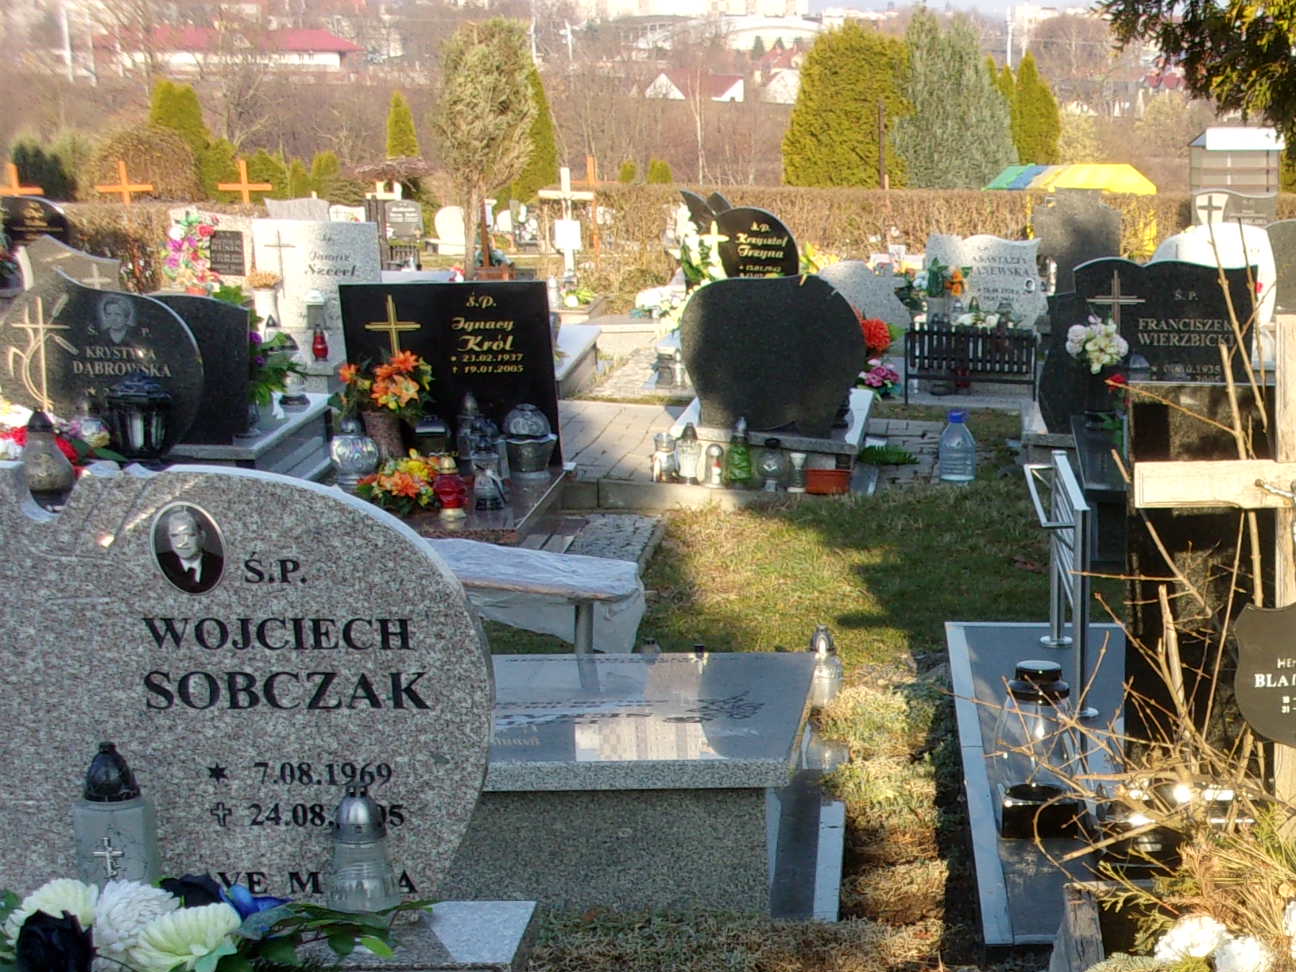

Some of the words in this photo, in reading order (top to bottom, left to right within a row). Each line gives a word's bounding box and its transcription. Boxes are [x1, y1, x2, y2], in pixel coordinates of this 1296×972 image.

[451, 317, 515, 332] Ignacy
[1137, 318, 1232, 330] FRANCISZEK
[457, 335, 514, 351] Król
[1137, 332, 1235, 347] WIERZBICKI
[85, 347, 158, 361] KRYSTYA
[72, 360, 173, 379] DĄBROWSKA
[143, 617, 415, 651] WOJCIECH
[143, 671, 432, 711] SOBCZAK
[254, 762, 392, 786] 7.08.1969
[250, 803, 405, 828] 24.08.05
[216, 871, 268, 895] VE
